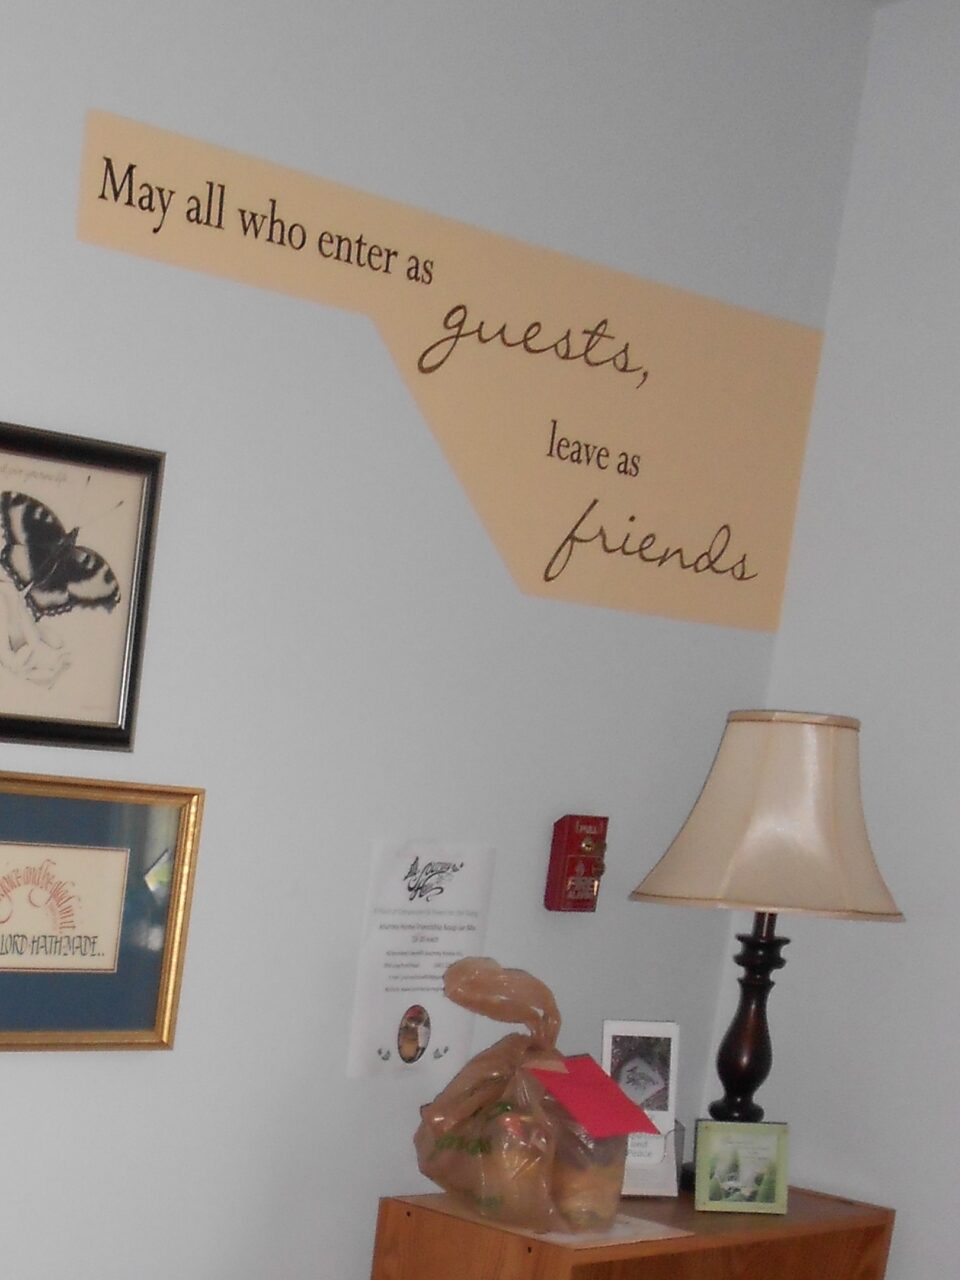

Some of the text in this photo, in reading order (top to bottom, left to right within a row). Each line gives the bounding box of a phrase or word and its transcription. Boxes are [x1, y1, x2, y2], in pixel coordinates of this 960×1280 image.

[98, 156, 435, 286] May all who enter as
[417, 304, 650, 389] guests,
[547, 420, 641, 478] leave as
[544, 499, 758, 583] friends
[0, 934, 28, 955] LORD
[30, 935, 61, 956] HATH
